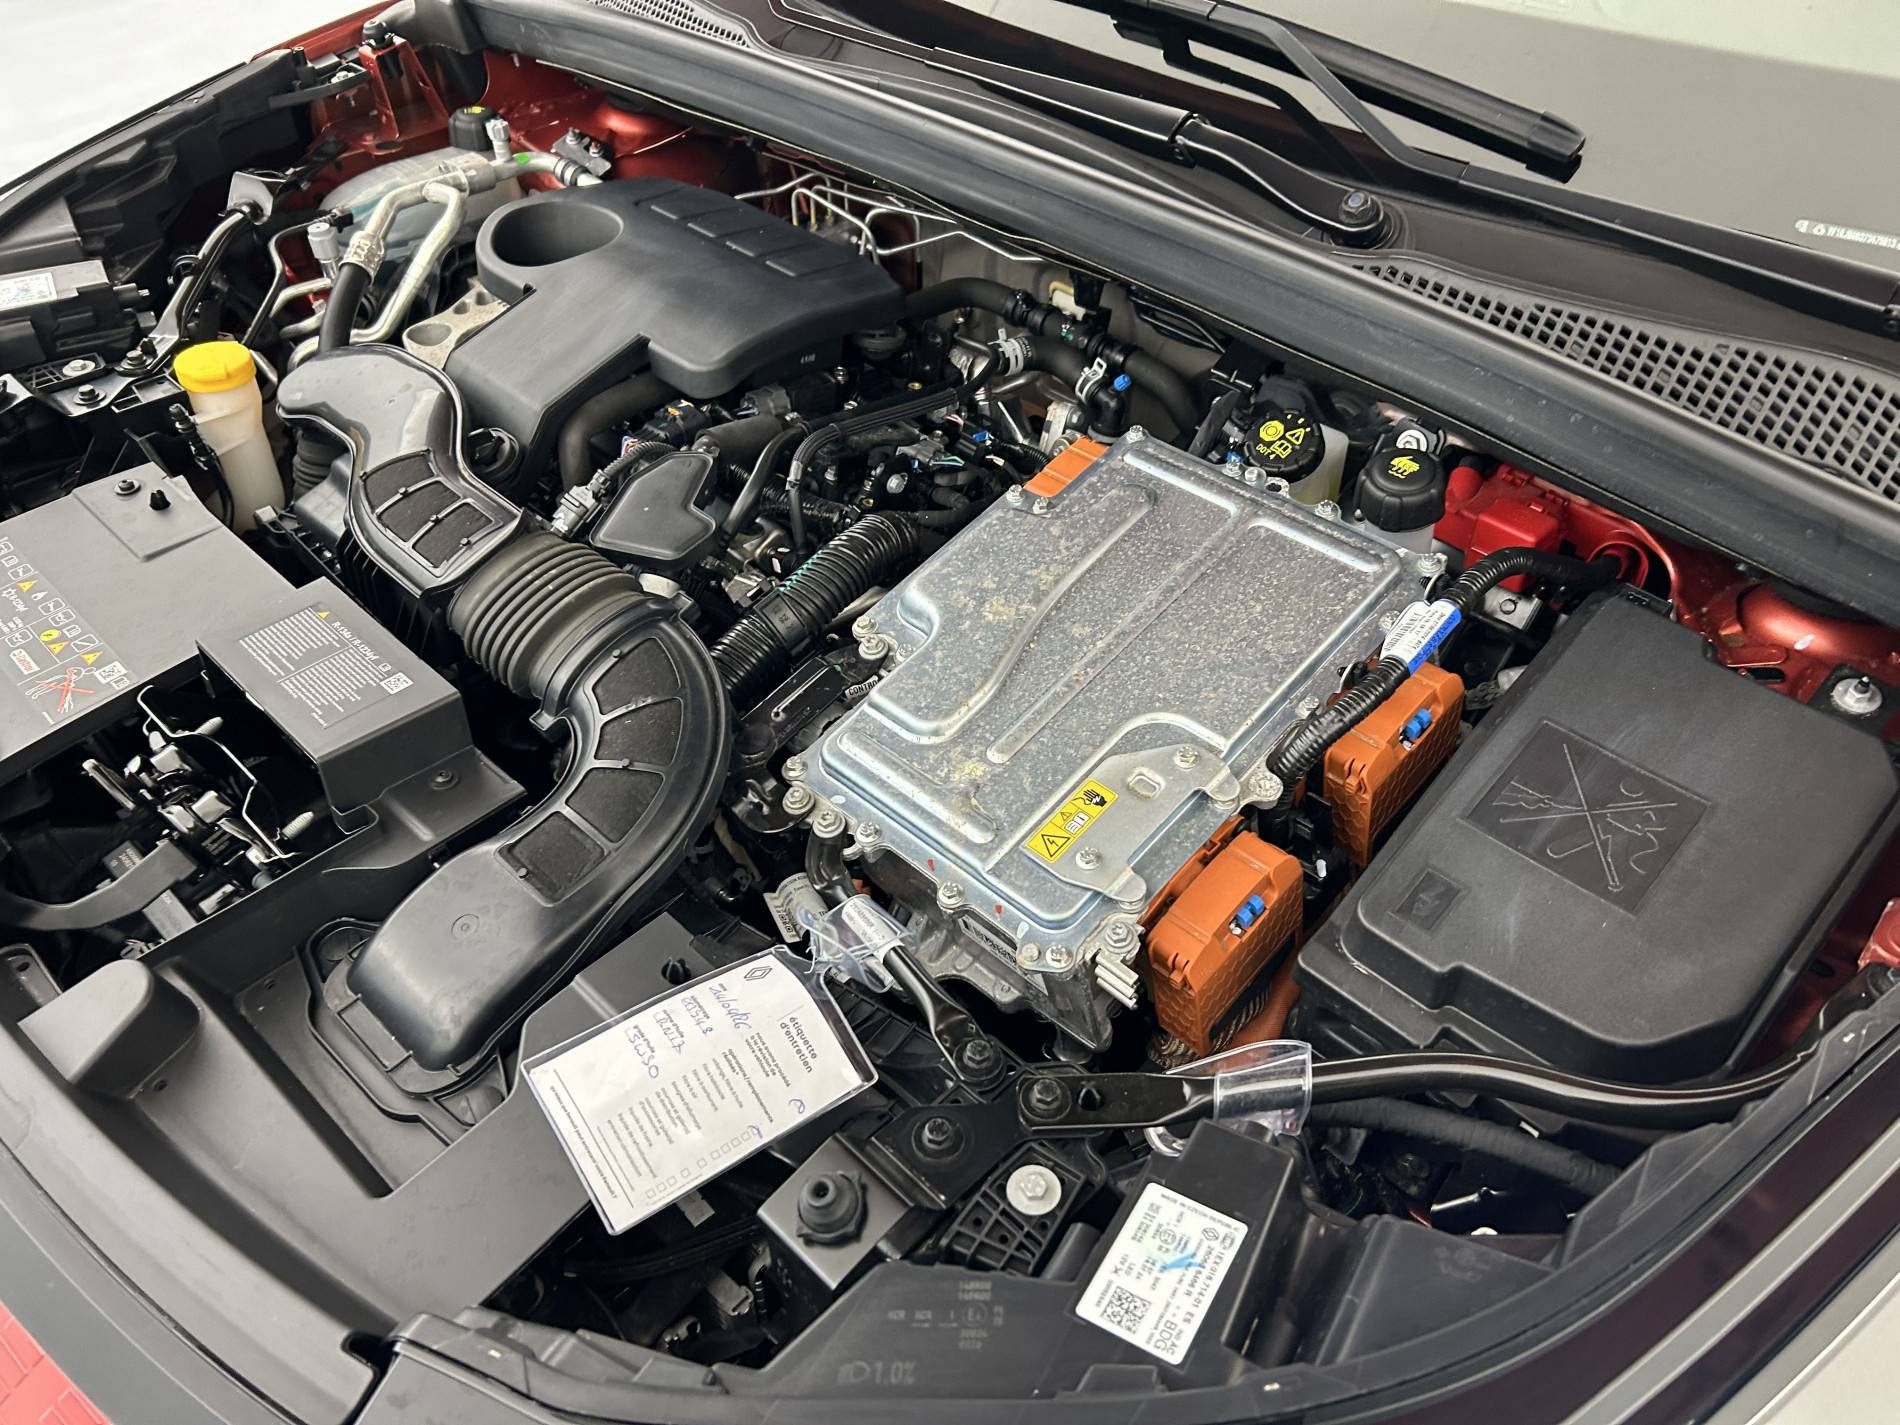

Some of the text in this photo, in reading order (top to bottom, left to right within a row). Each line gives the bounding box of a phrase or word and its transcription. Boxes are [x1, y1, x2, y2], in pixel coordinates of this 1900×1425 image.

[1256, 443, 1272, 456] DOT
[779, 1020, 814, 1073] d'entretien
[787, 1014, 819, 1060] étiquette
[1152, 1318, 1178, 1352] BDG
